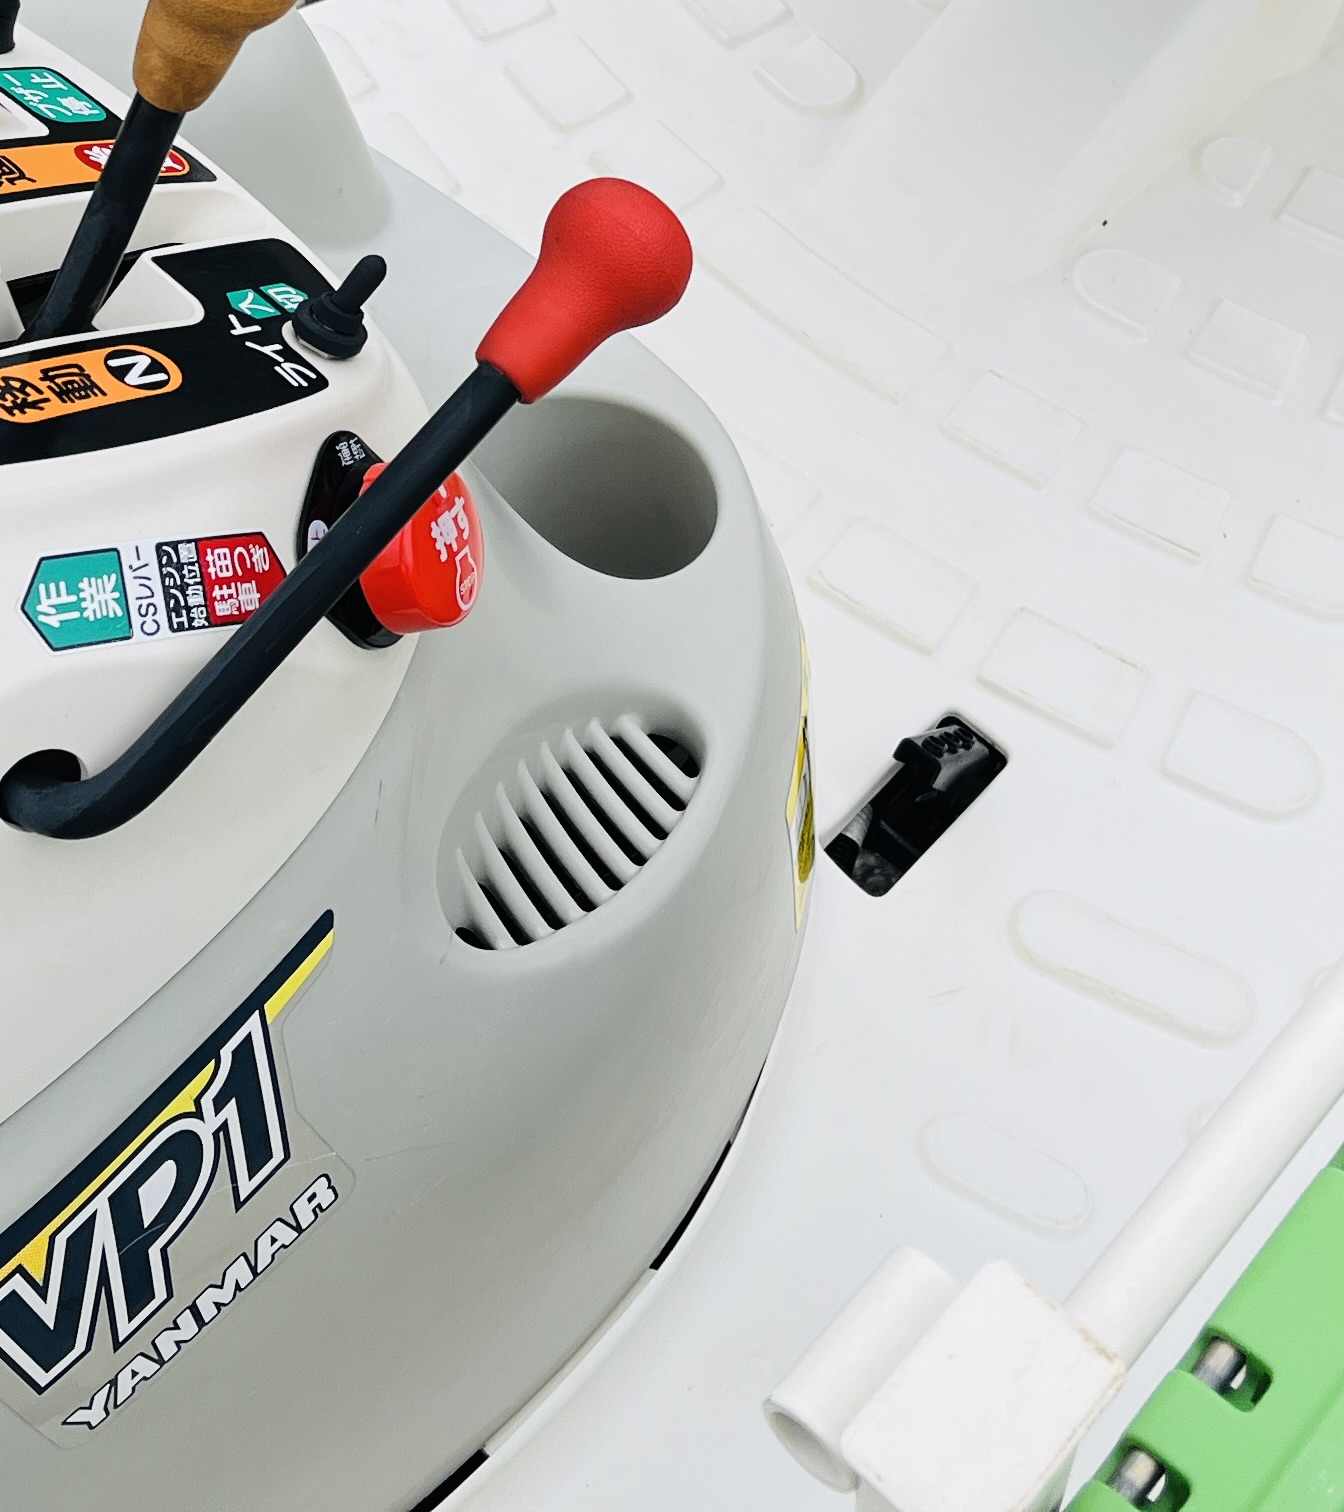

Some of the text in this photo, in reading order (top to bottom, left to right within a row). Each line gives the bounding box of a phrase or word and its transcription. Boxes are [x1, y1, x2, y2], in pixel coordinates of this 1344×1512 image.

[1, 72, 72, 119] ブザー
[105, 355, 170, 385] N
[227, 313, 317, 387] ライト
[126, 545, 162, 637] CSレバー
[158, 543, 189, 629] エンジン
[178, 541, 210, 629] 始動位置
[207, 544, 271, 575] 苗つぎ
[37, 573, 124, 626] 作業
[213, 580, 262, 616] 駐車
[61, 1172, 338, 1430] YANMAR
